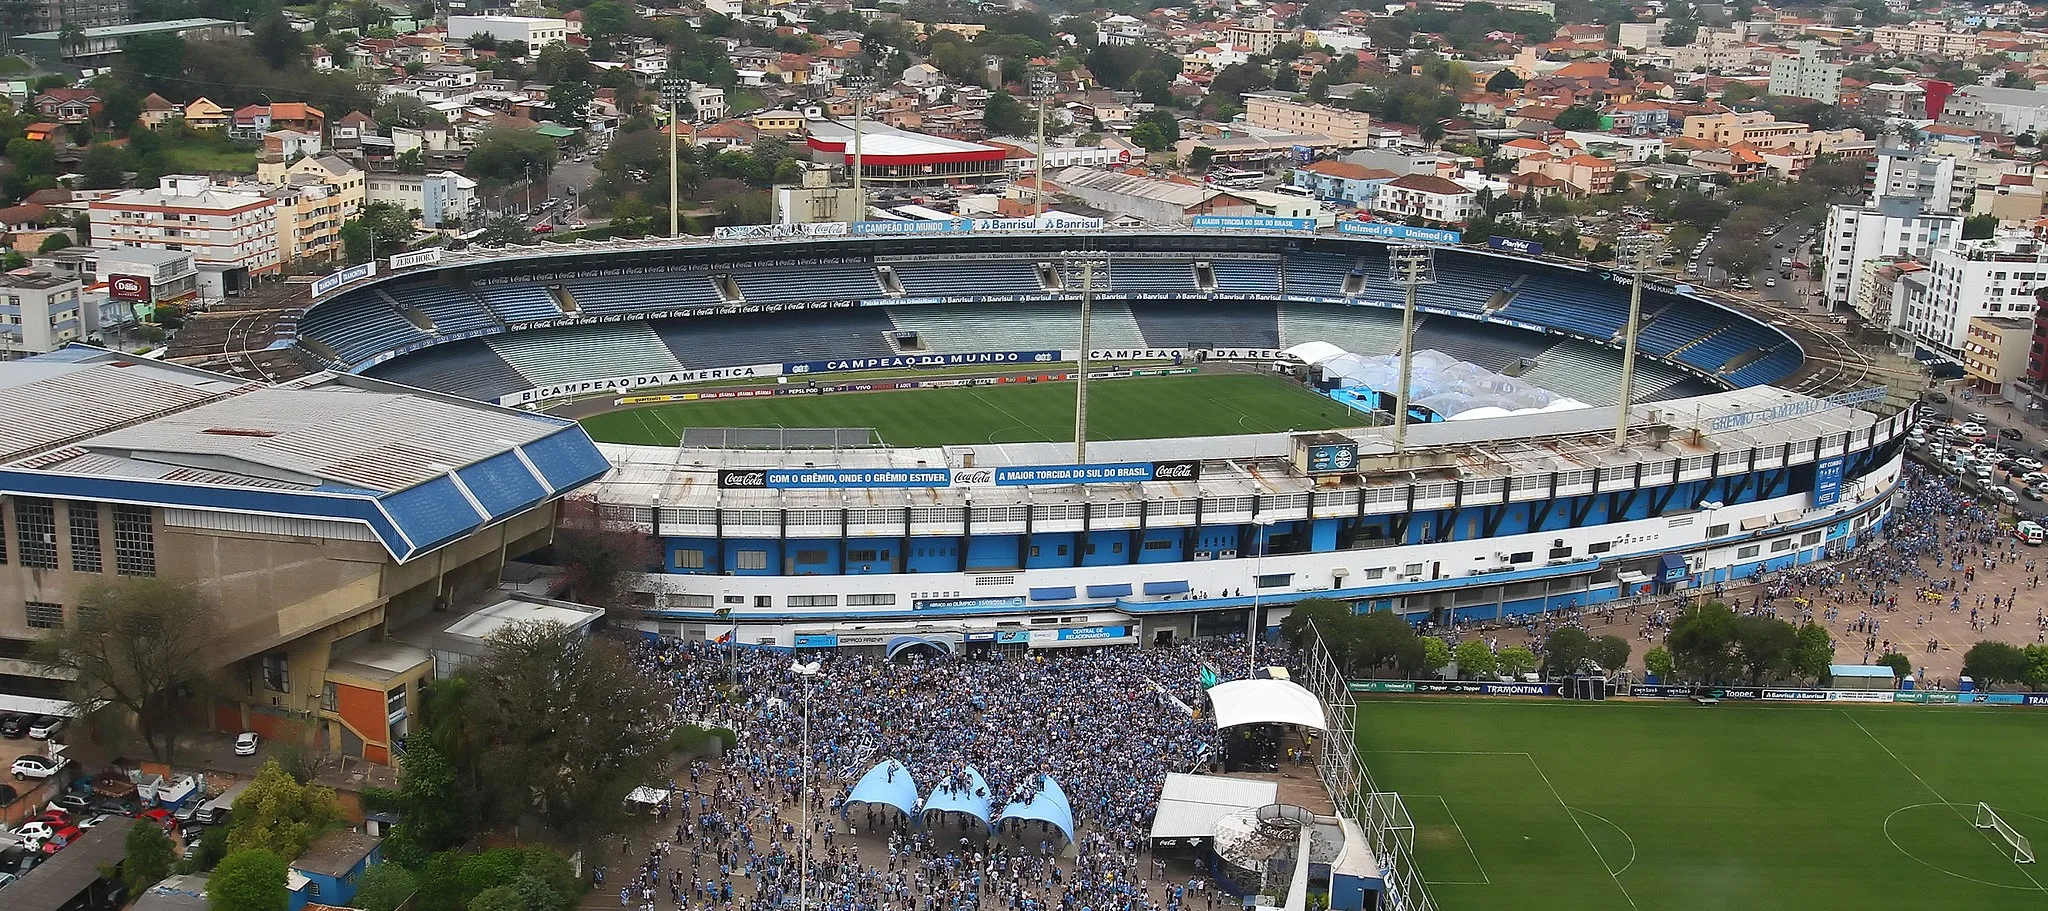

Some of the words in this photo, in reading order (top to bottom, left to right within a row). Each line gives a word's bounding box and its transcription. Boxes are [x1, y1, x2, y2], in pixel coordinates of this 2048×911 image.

[865, 222, 902, 232] CAMPEÃO
[903, 222, 914, 231] DO
[916, 221, 943, 231] MUNDO
[992, 218, 1036, 229] Banrisul
[1056, 217, 1100, 229] Banrisul
[1202, 218, 1220, 226] MAIOR
[1221, 218, 1243, 226] TORCIDA
[1253, 219, 1264, 227] SUL
[1265, 219, 1273, 227] DO
[1274, 220, 1294, 228] BRASIL
[1344, 223, 1380, 235] Unimed
[1405, 228, 1440, 240] Unimed
[1502, 238, 1529, 250] PanVel
[396, 257, 416, 267] ZERO
[416, 252, 435, 264] HORA
[1612, 273, 1633, 285] Topper
[922, 356, 944, 364] DO
[950, 353, 1018, 363] MUNDO
[637, 376, 660, 385] DA
[668, 366, 755, 382] AMÉRICA
[999, 471, 1005, 481] A
[1007, 470, 1034, 481] MAIOR
[1036, 469, 1071, 480] TORCIDA
[1073, 469, 1085, 478] DO
[1087, 468, 1102, 478] SUL
[1104, 467, 1116, 478] DO
[1118, 465, 1148, 477] BRASIL.
[1155, 464, 1193, 478] Coca-Cola
[724, 471, 764, 486] Coca-Cola
[769, 473, 790, 483] COM
[792, 473, 798, 483] O
[800, 472, 837, 484] GRÊMIO,
[839, 472, 863, 482] ONDE
[865, 473, 871, 482] O
[873, 471, 908, 482] GRÊMIO
[909, 472, 947, 483] ESTIVER.
[954, 471, 992, 485] Coca-Cola
[1819, 492, 1835, 502] NET
[1841, 523, 1846, 534] 5
[1066, 632, 1110, 640] RELACIONAMENTO
[1487, 685, 1543, 694] TRAMONTINA
[1725, 689, 1754, 698] Topper
